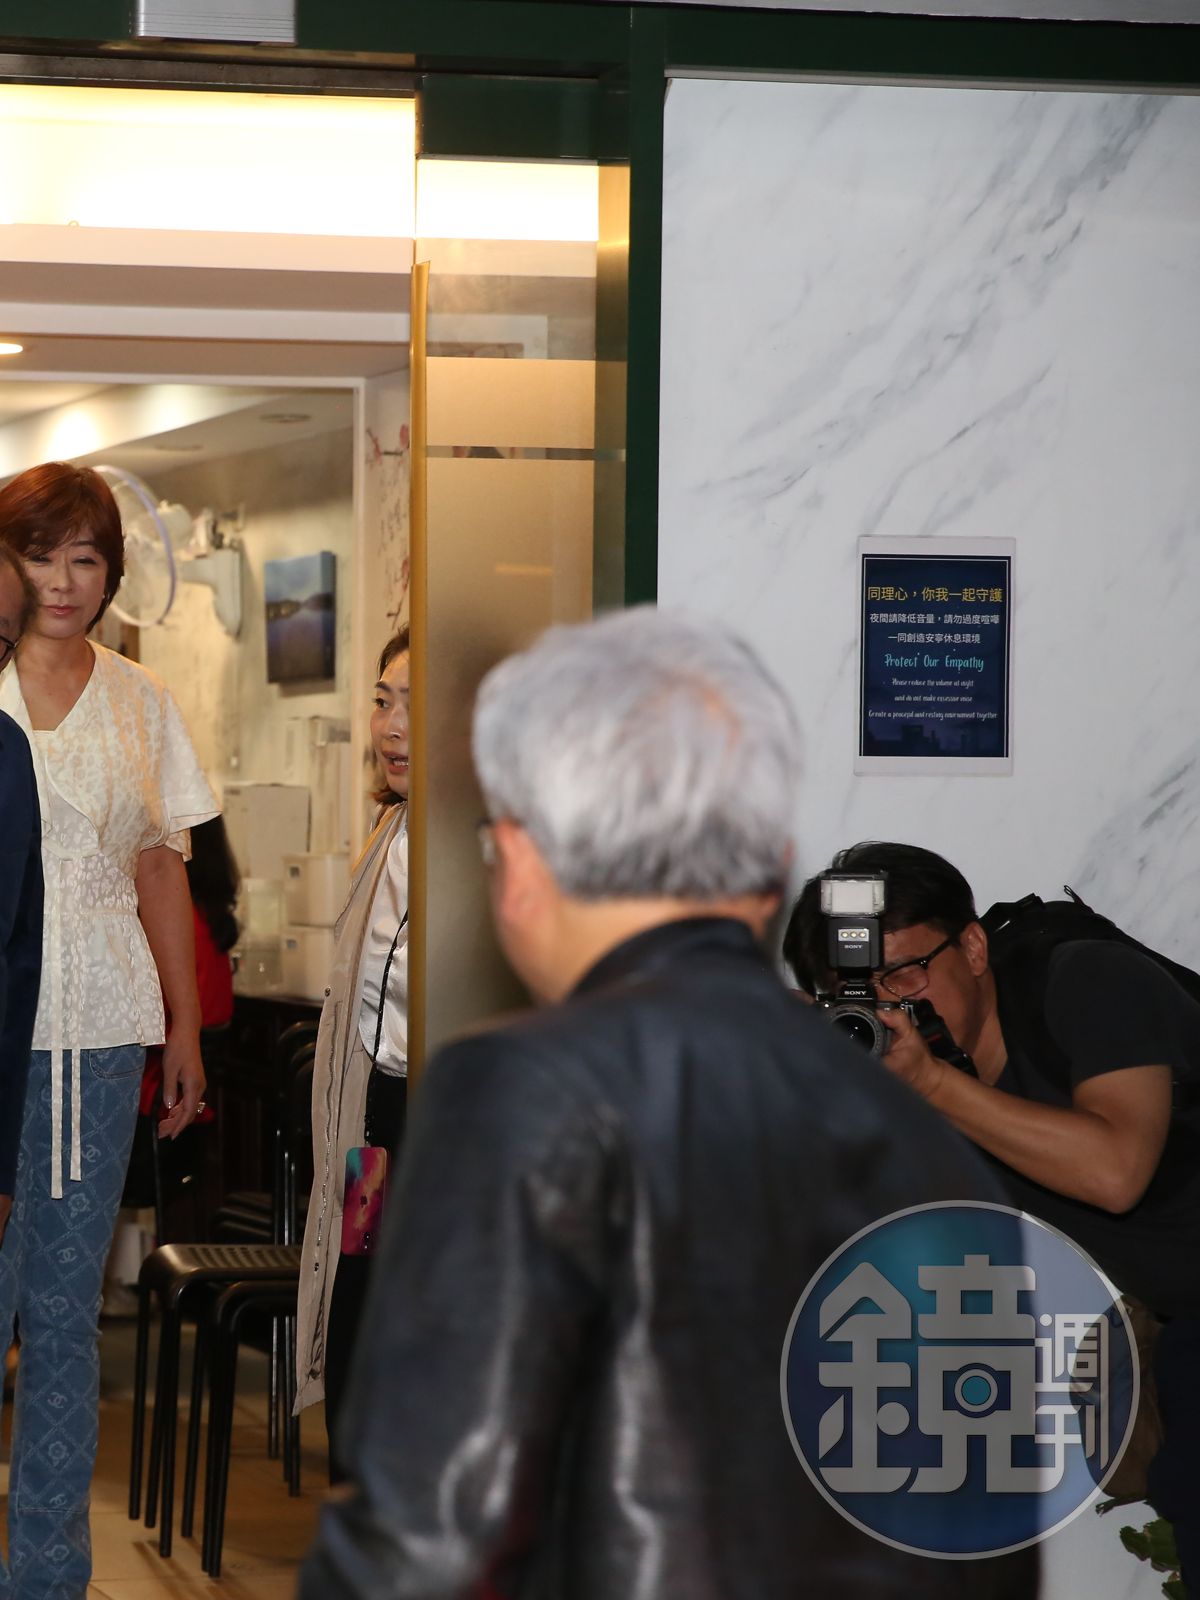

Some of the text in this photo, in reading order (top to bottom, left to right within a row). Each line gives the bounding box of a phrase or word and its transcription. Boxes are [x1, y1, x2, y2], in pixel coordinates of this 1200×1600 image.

[867, 586, 1003, 603] 同理心，你我一起守護
[884, 653, 984, 673] Protect Our Empathy
